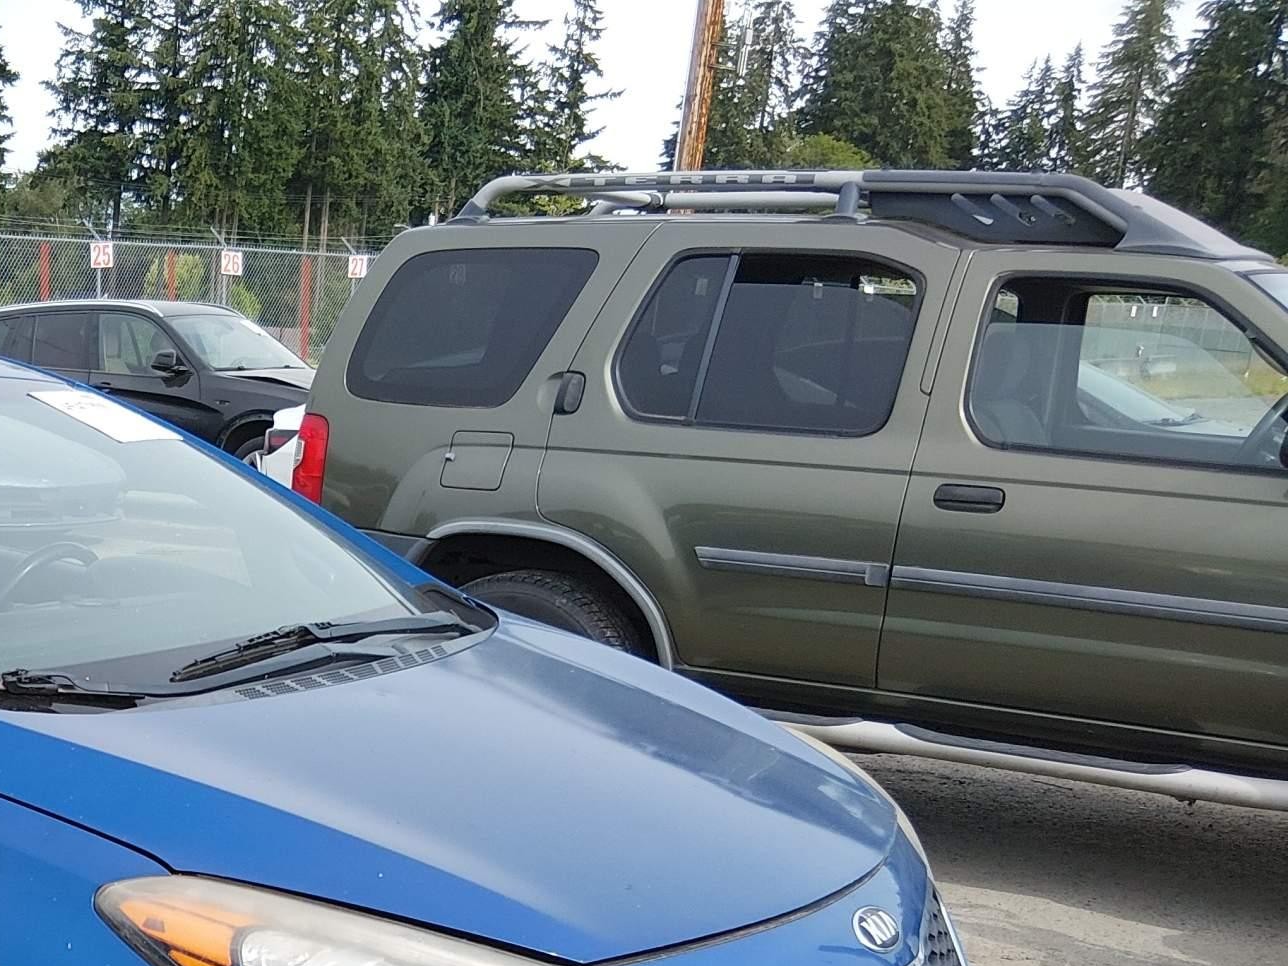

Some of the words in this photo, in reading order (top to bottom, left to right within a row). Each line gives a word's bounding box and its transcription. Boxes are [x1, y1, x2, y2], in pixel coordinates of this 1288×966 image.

[521, 173, 798, 191] XTERRA
[93, 244, 111, 266] 25
[223, 253, 240, 273] 26
[350, 258, 364, 277] 27
[859, 910, 898, 945] KIA
